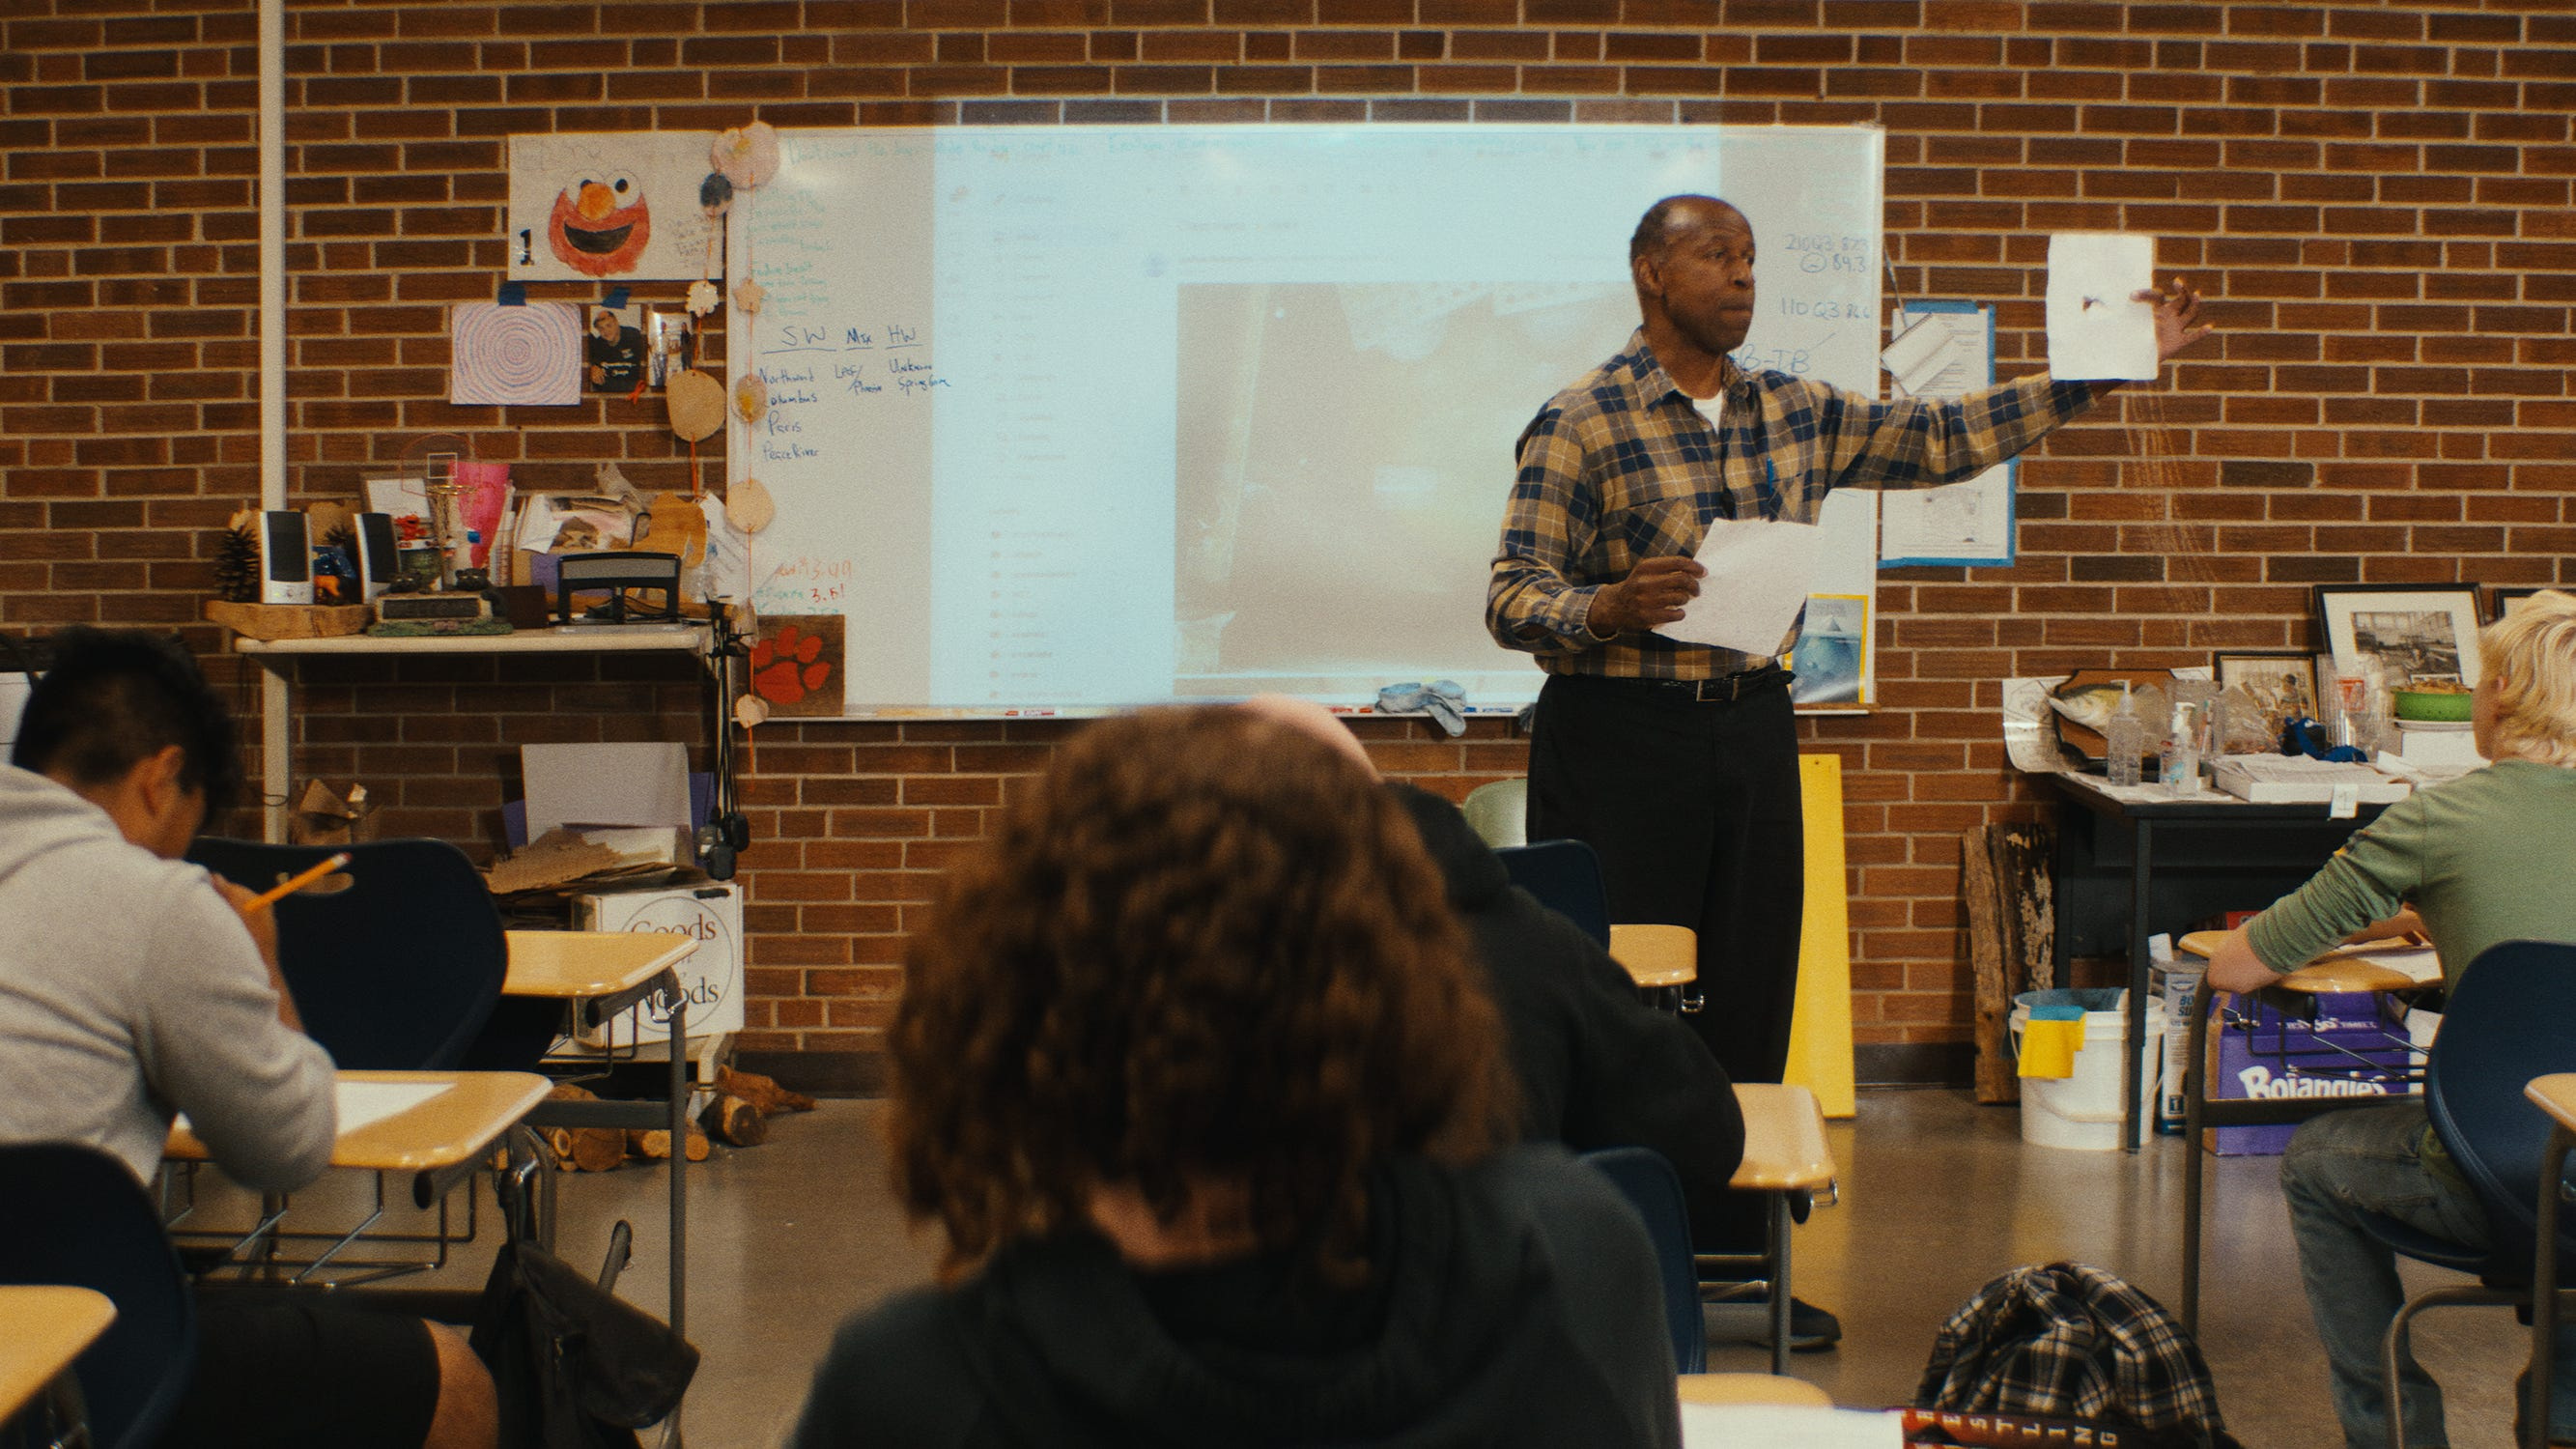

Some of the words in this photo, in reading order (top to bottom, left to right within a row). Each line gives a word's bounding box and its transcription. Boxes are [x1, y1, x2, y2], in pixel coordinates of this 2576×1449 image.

[780, 325, 826, 347] SW
[769, 388, 819, 407] olumbus
[1901, 1409, 2118, 1446] RESTLING
